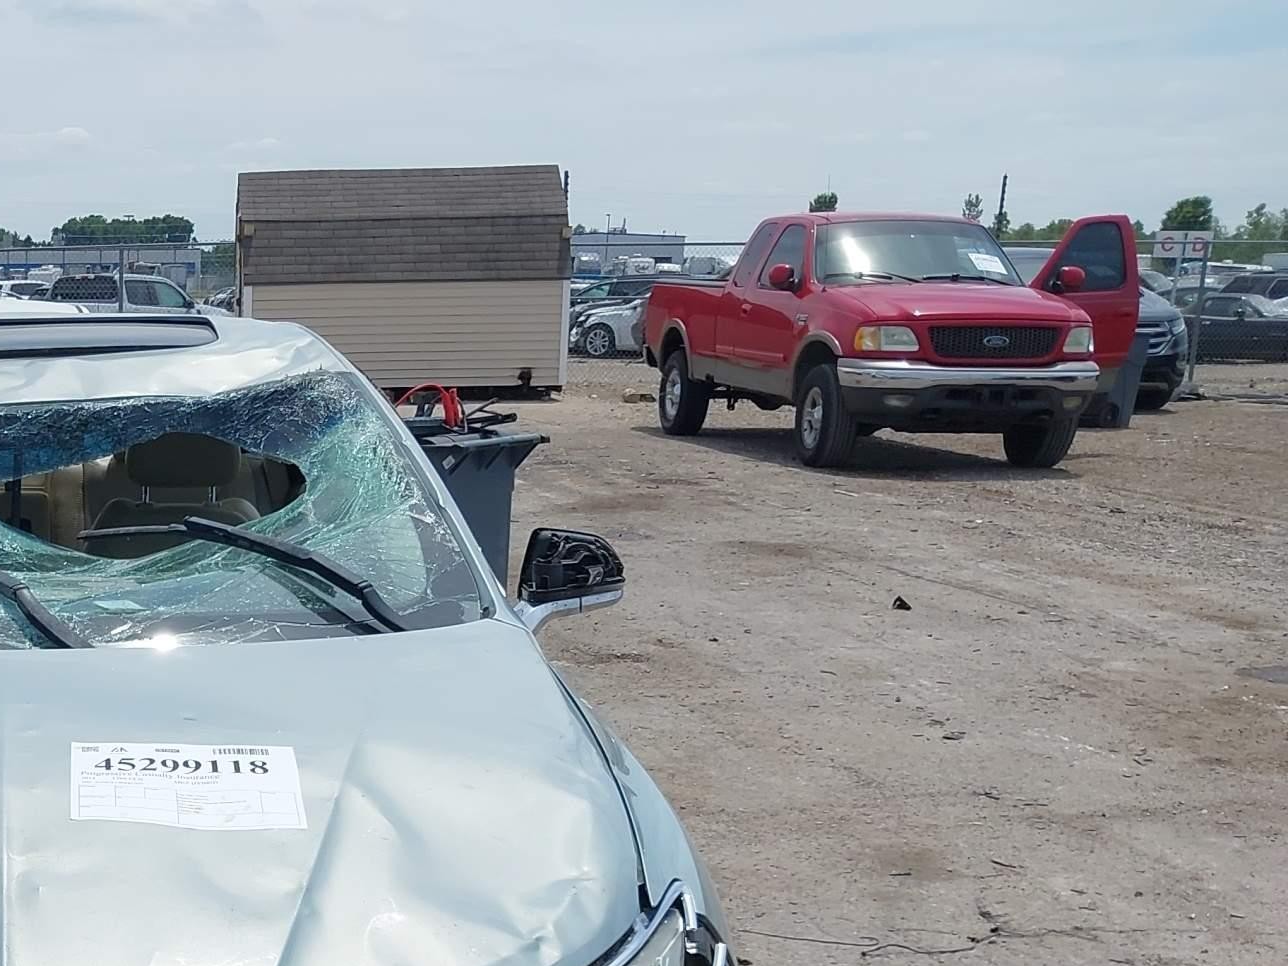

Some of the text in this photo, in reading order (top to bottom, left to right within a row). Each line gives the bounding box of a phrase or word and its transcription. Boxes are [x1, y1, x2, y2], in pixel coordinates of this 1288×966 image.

[1161, 236, 1205, 252] C D
[94, 757, 269, 775] 45299118
